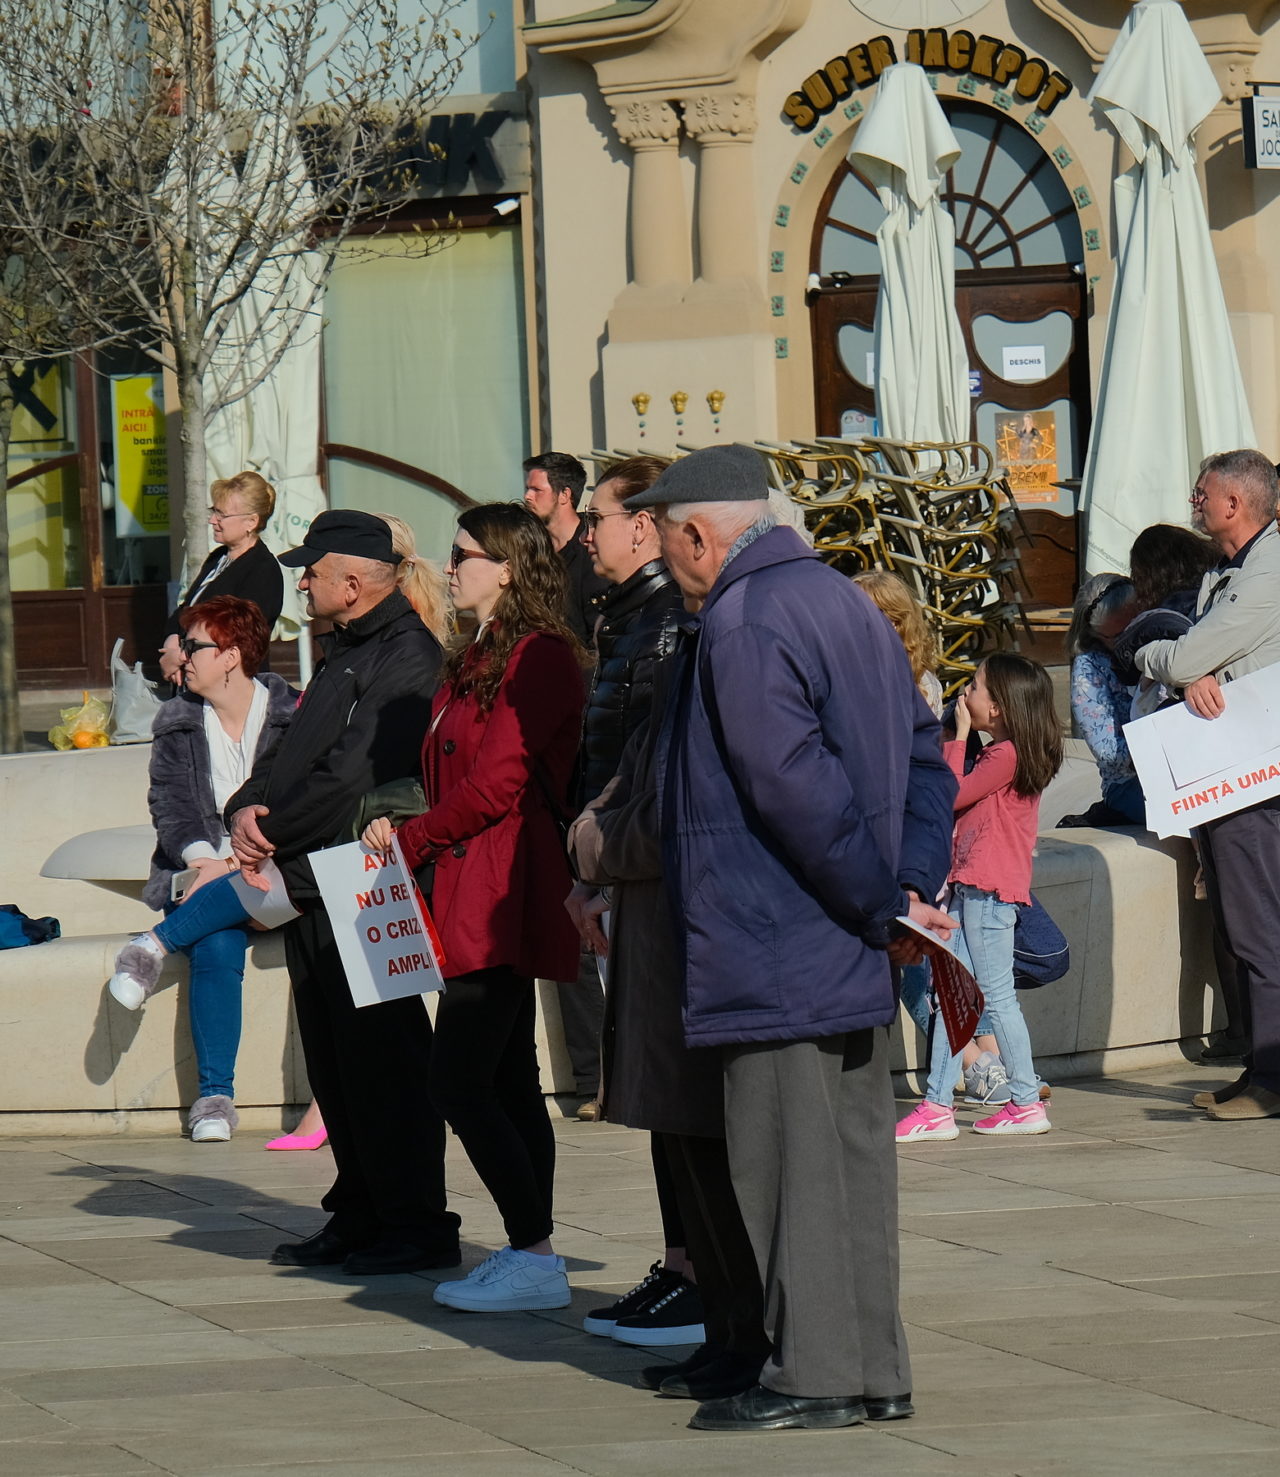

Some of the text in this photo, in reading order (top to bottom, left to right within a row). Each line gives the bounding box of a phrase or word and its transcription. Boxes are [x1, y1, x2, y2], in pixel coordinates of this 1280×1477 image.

[782, 28, 1073, 131] SUPER JACKPOT
[1009, 358, 1041, 366] DESCHIS
[1171, 779, 1234, 815] FIINȚĂ
[355, 883, 411, 910] NU RE
[367, 917, 422, 944] O CRIZ
[388, 951, 435, 977] AMPLI
